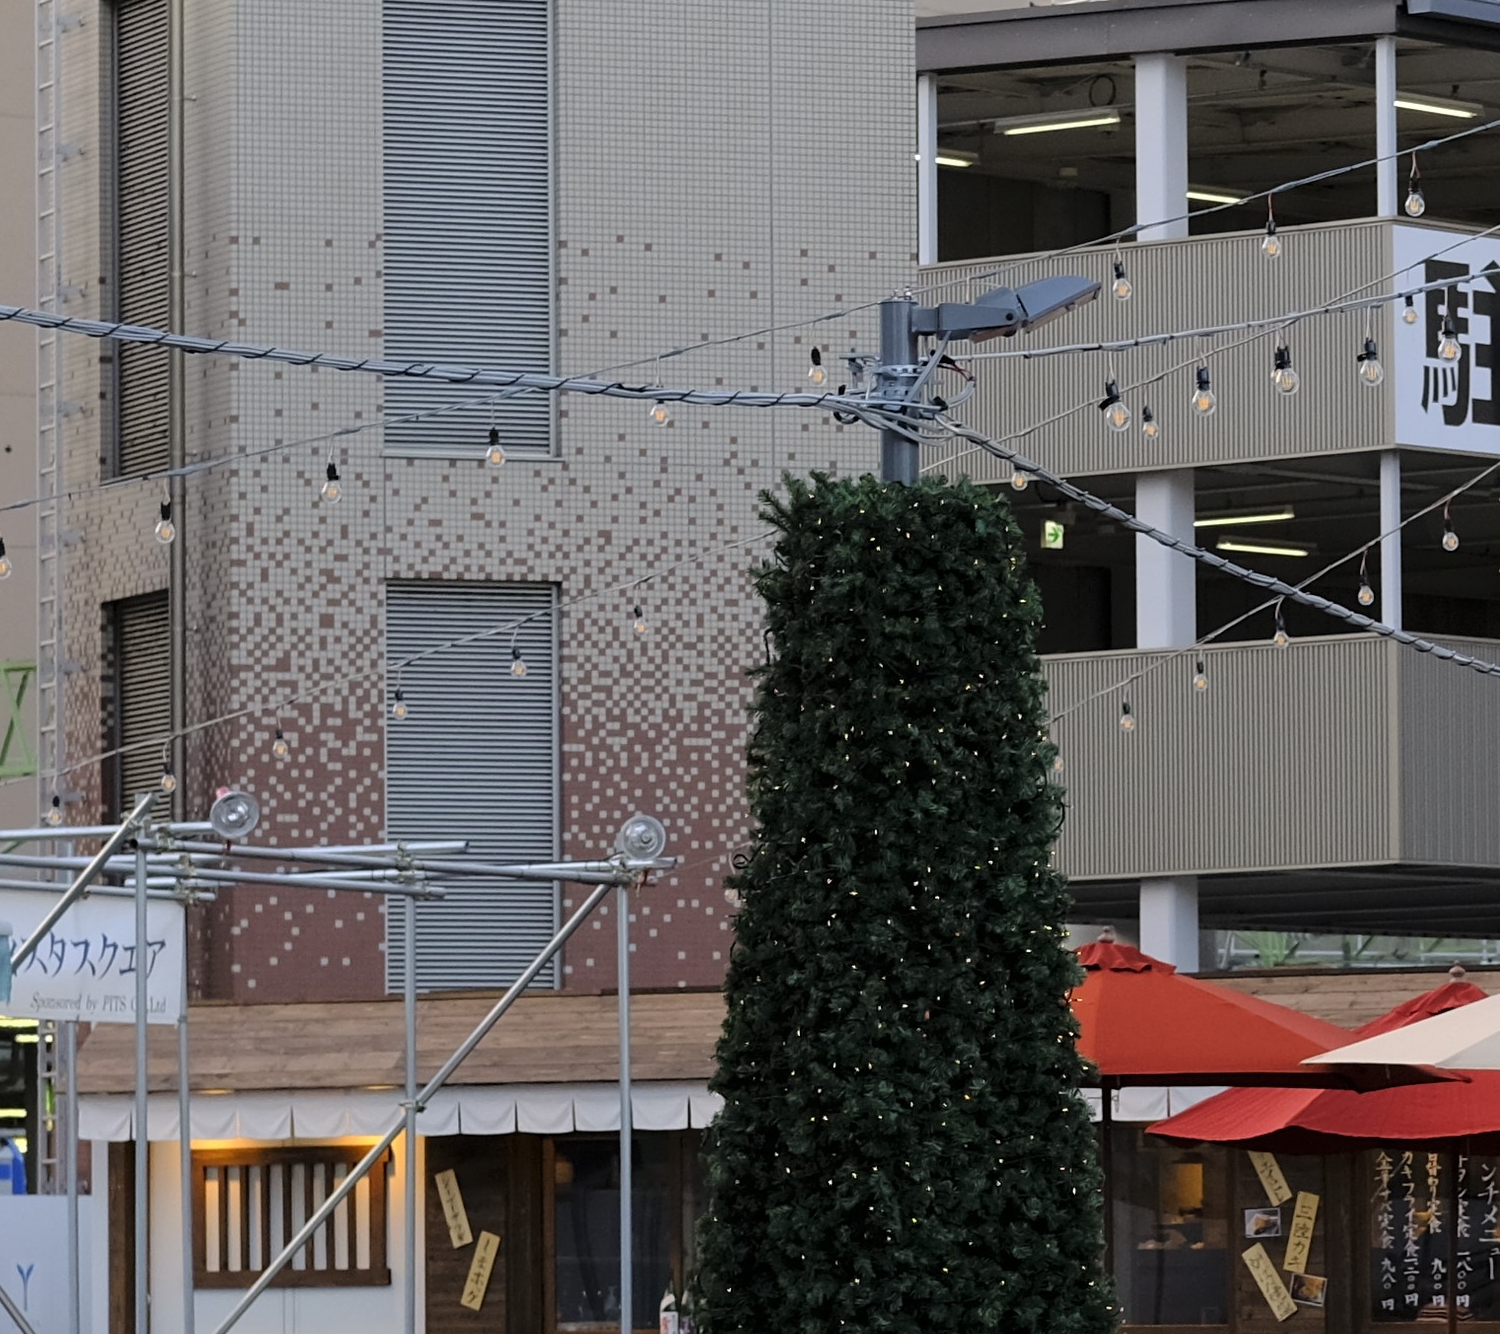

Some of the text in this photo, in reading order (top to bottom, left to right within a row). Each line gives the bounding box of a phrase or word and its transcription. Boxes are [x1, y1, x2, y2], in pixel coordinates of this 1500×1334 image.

[30, 992, 126, 1014] Sponsored by PITS
